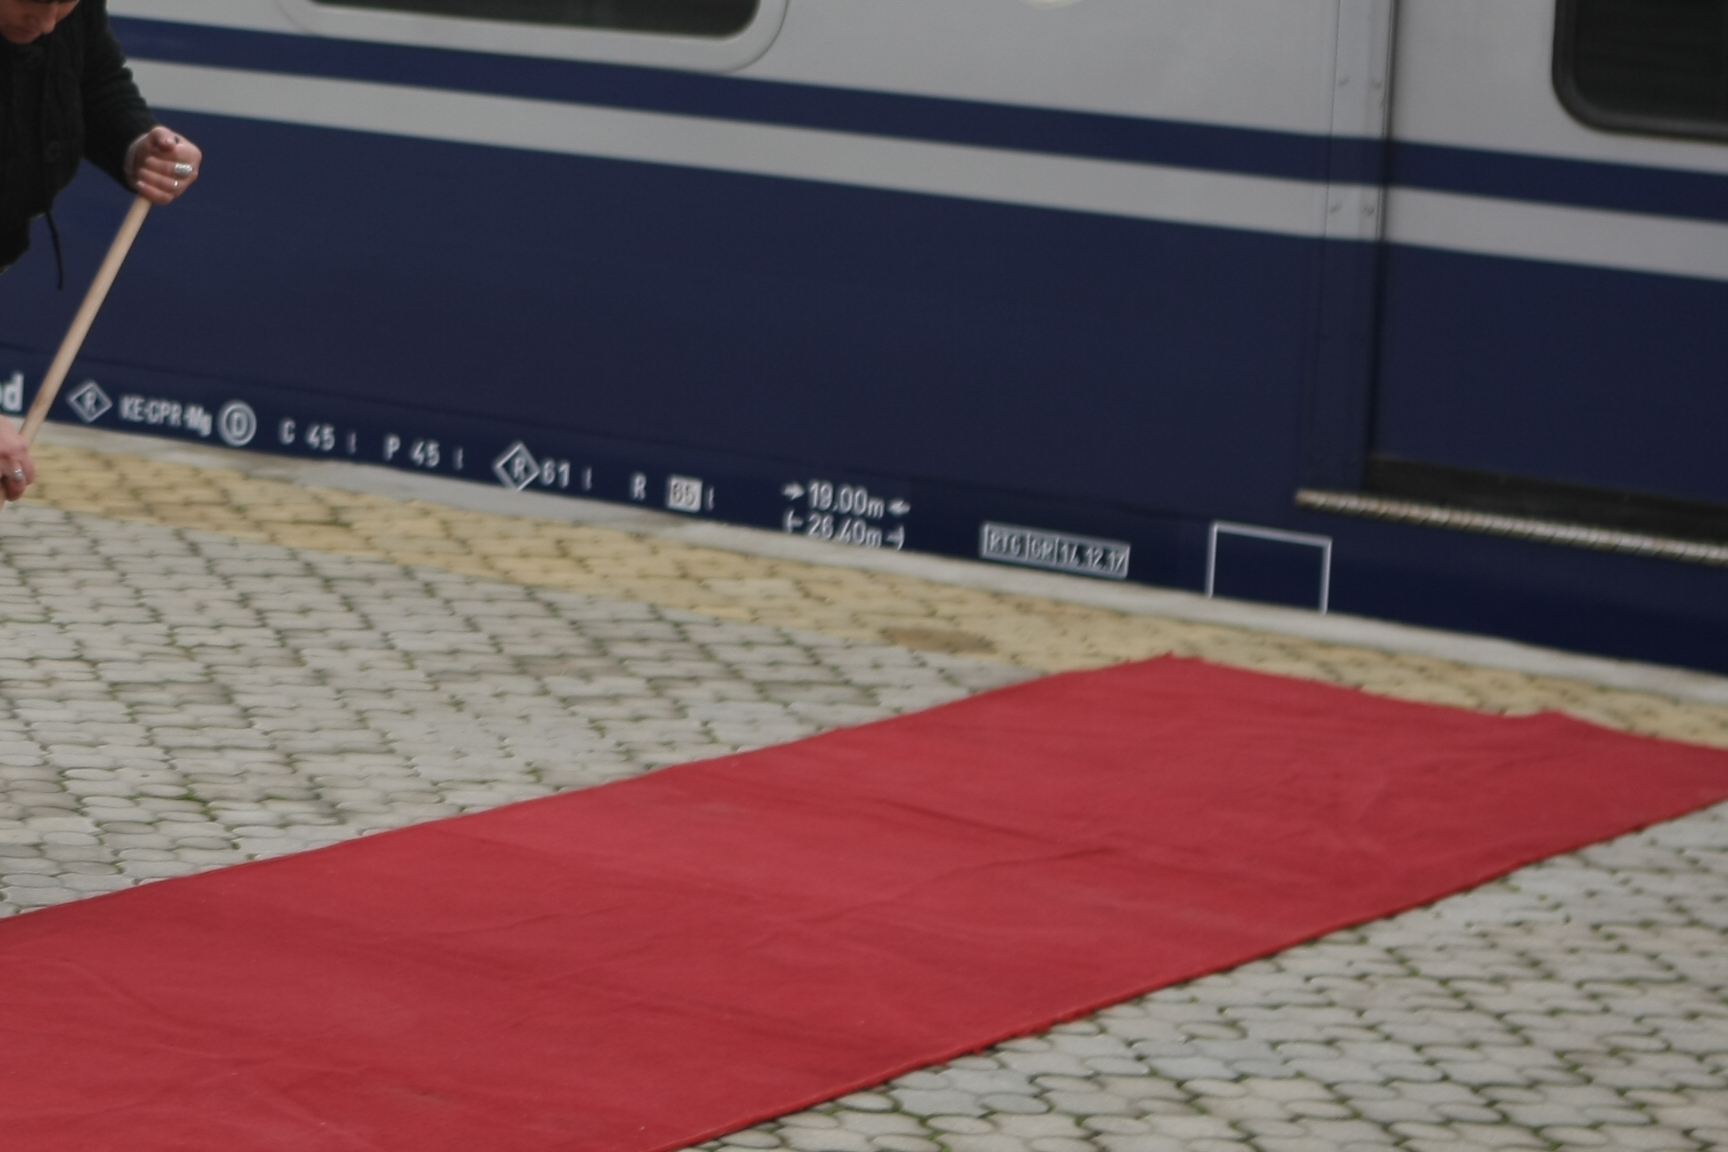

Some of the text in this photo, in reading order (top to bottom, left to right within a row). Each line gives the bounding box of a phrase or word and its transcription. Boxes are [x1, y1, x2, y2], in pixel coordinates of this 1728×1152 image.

[306, 425, 334, 450] 45
[383, 434, 400, 461] P
[411, 440, 439, 468] 45
[631, 472, 646, 501] R
